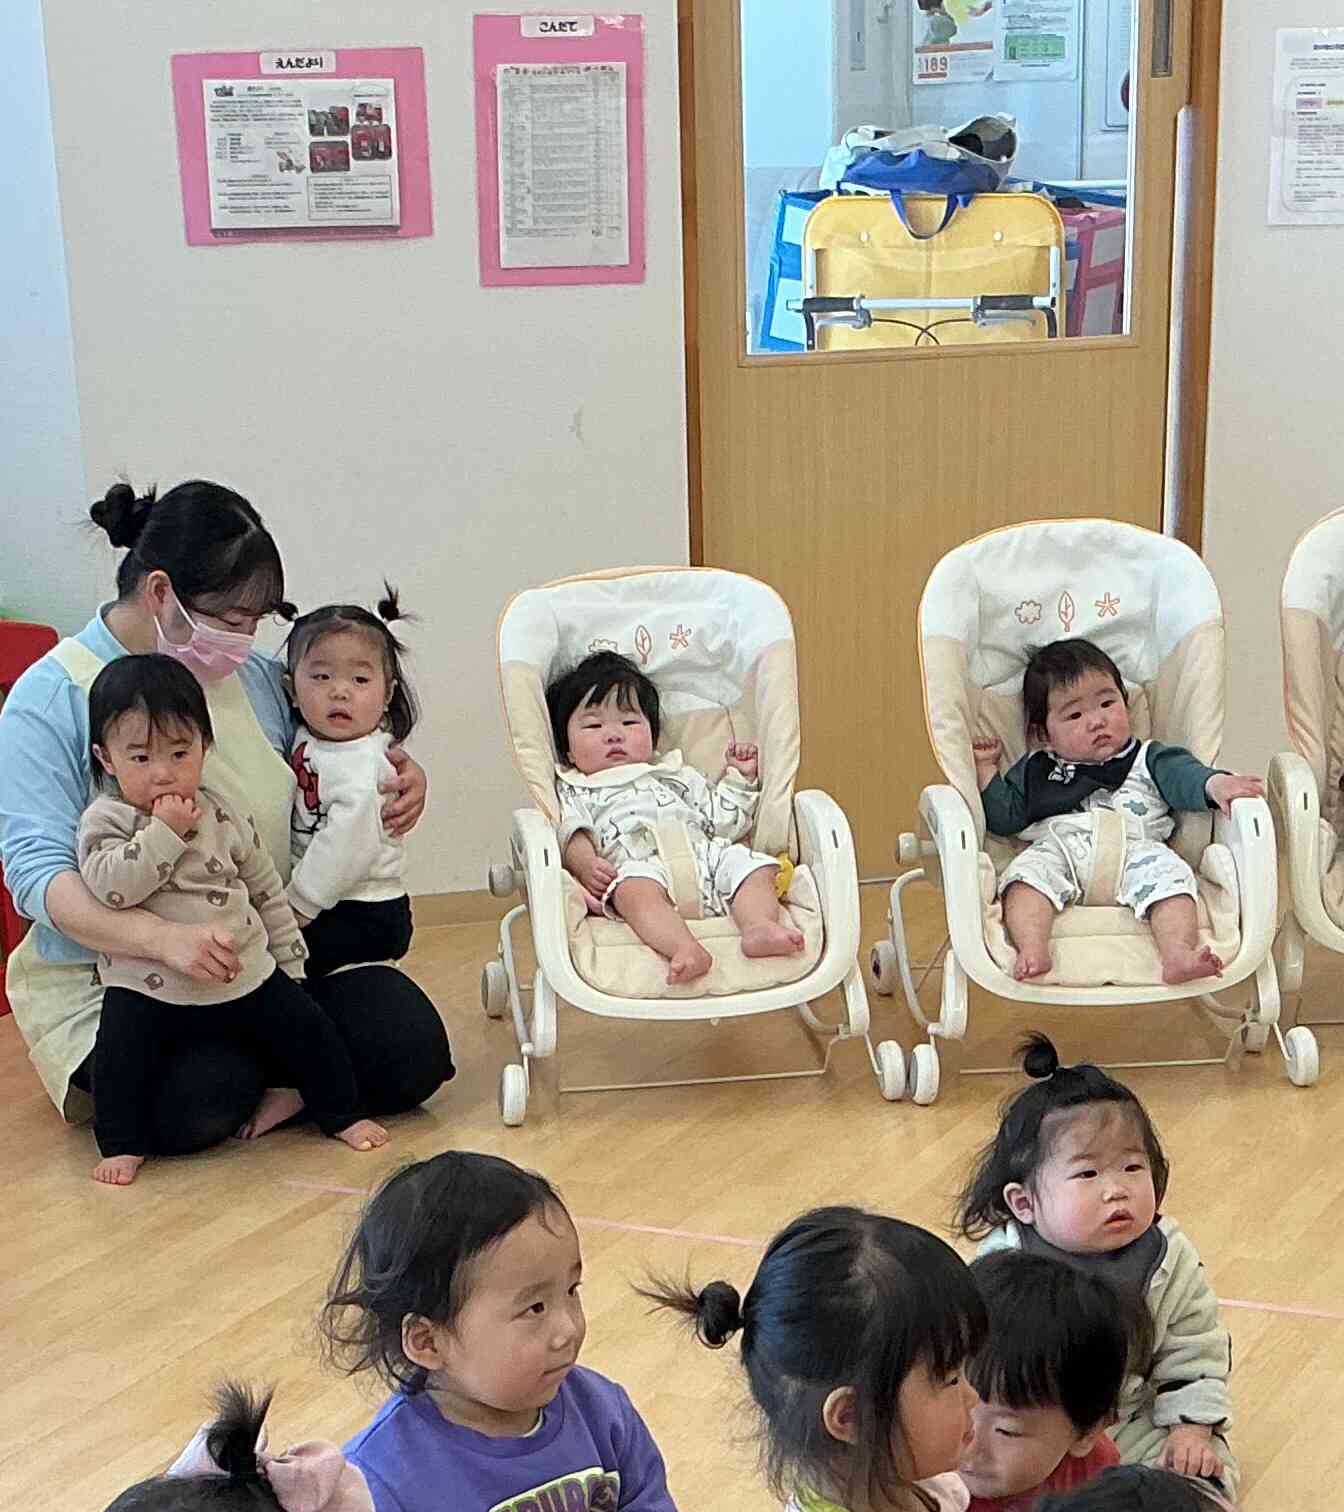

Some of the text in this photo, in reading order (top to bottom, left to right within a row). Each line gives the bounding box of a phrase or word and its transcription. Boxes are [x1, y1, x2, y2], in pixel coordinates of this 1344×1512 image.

[275, 56, 323, 69] えんだより
